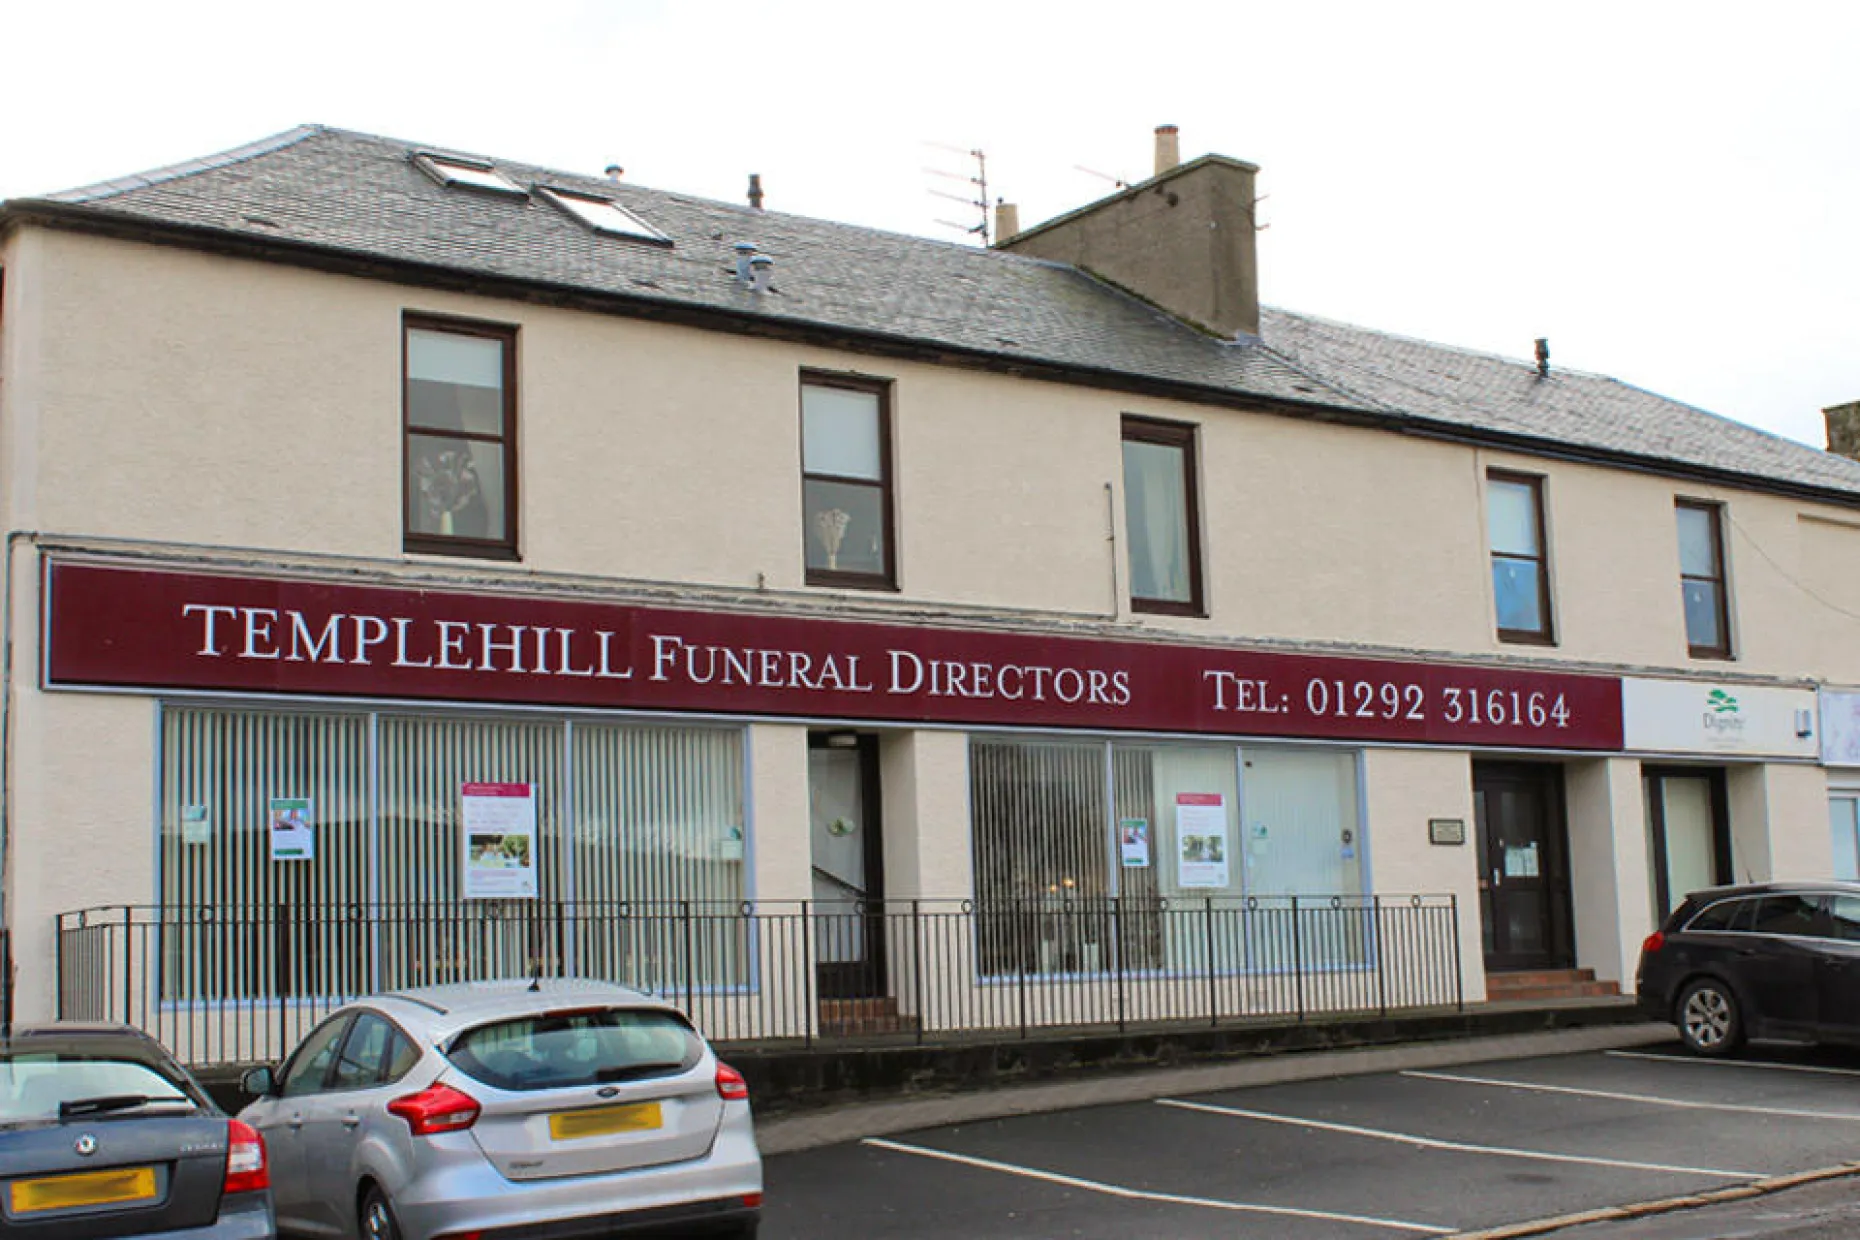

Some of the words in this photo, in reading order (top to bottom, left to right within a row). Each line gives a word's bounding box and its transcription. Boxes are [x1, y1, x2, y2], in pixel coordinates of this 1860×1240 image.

[182, 602, 633, 680] TEMPLEHILL
[649, 633, 874, 694] FUNERAL
[887, 650, 1132, 706] DIRECTORS
[1202, 669, 1289, 715] TEL:
[1305, 676, 1426, 721] 01292
[1442, 687, 1571, 729] 316164
